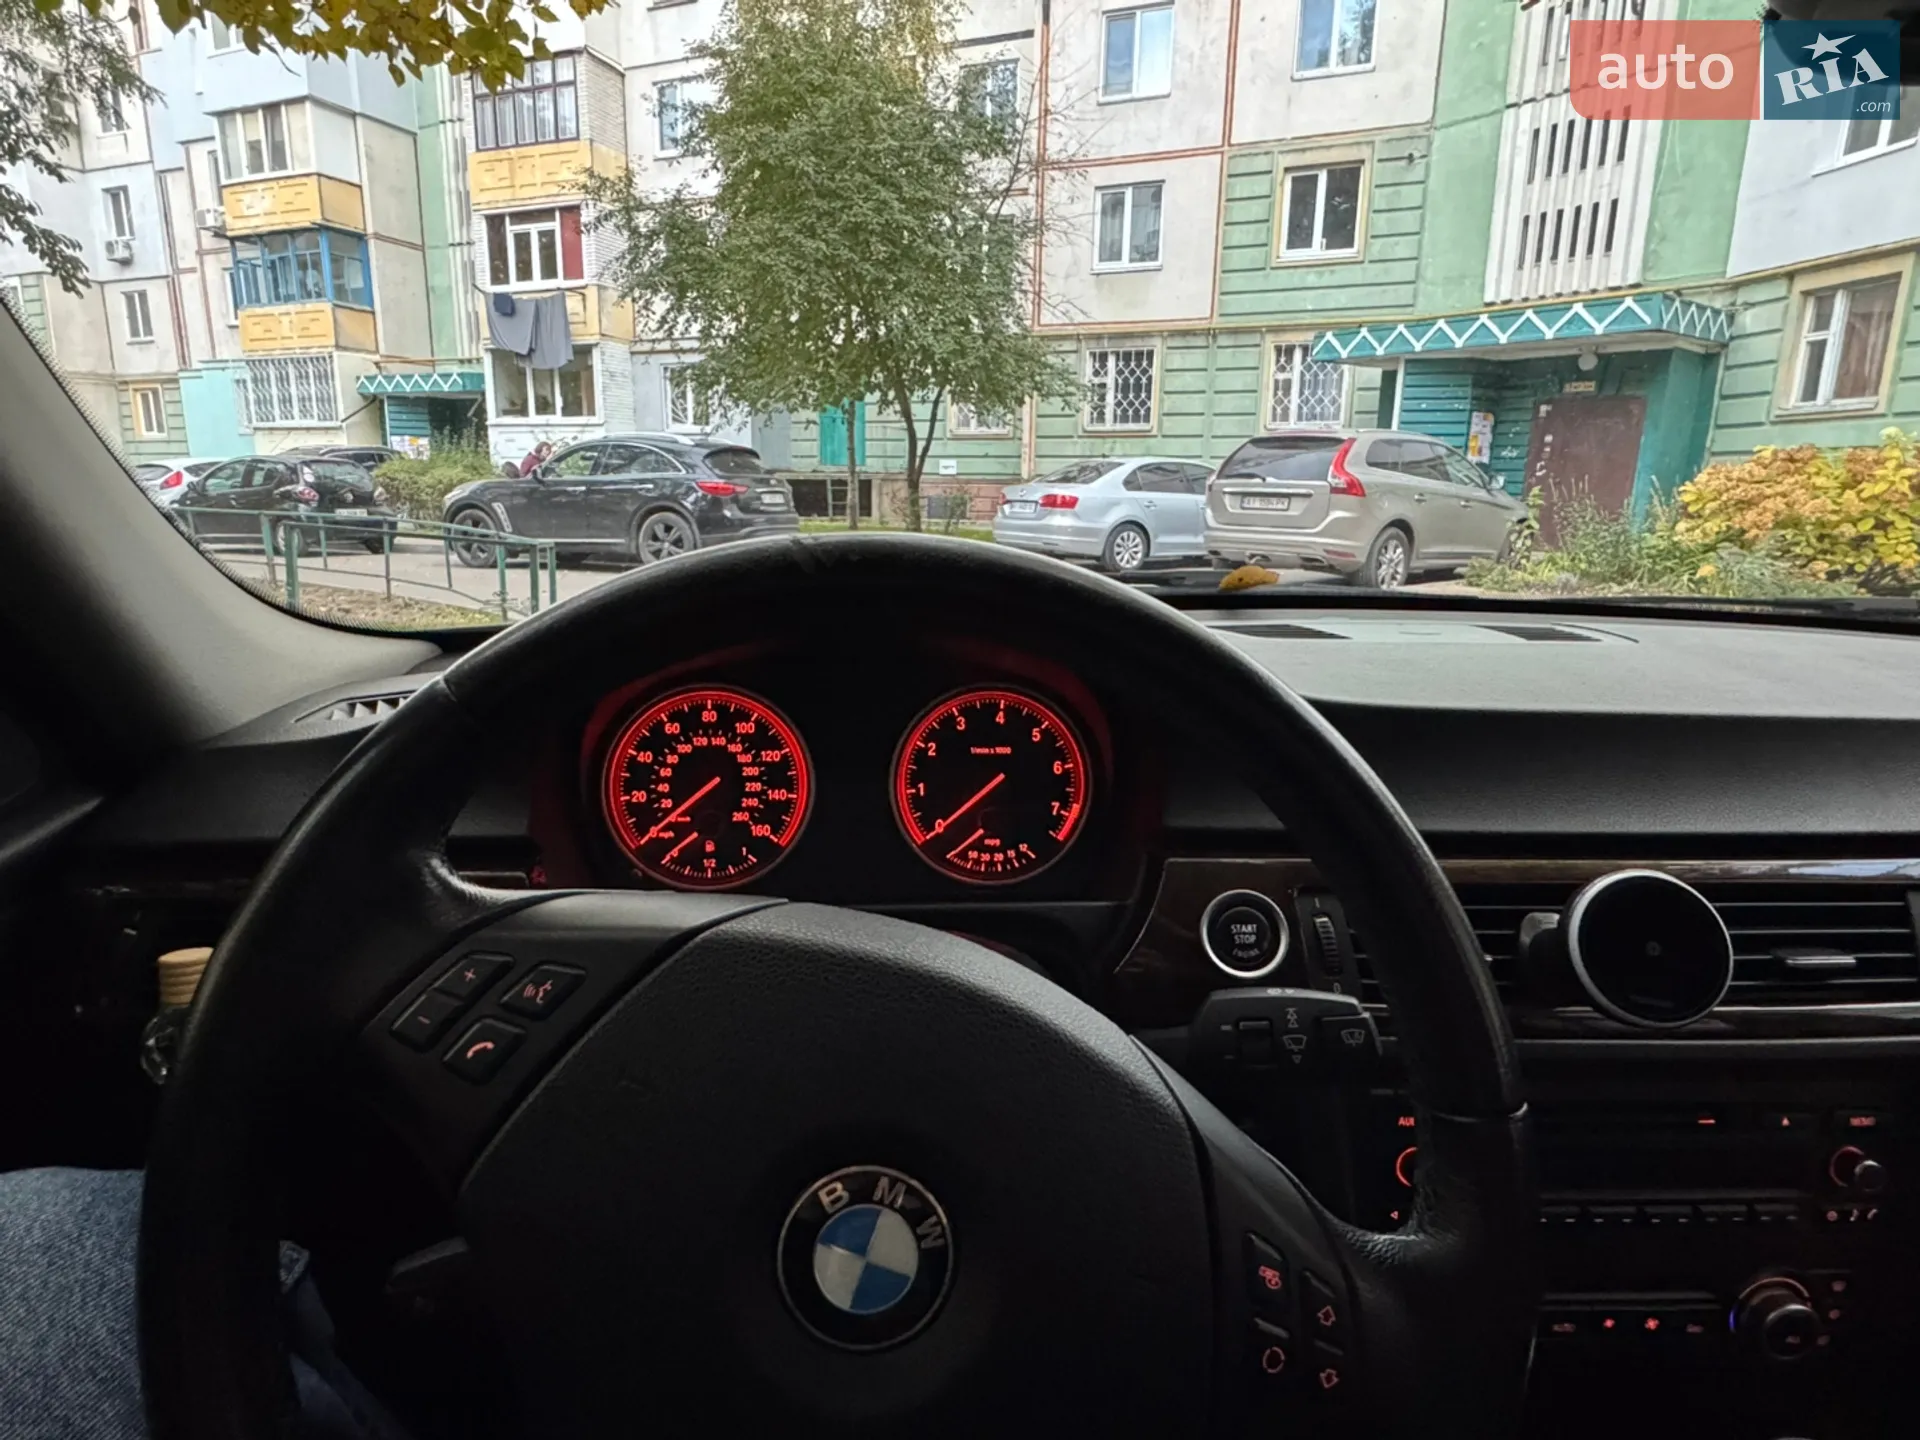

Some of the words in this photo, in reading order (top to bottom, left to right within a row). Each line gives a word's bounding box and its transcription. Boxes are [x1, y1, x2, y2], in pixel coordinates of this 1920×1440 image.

[702, 711, 717, 722] 80
[995, 712, 1005, 725] 4
[665, 723, 680, 734] 60
[735, 723, 755, 734] 100
[956, 717, 966, 731] 3
[1031, 728, 1041, 742] 5
[927, 742, 937, 756] 2
[637, 752, 653, 763] 40
[761, 751, 781, 762] 120
[742, 767, 759, 776] 200
[1053, 761, 1062, 775] 6
[657, 783, 669, 793] 40
[745, 782, 762, 791] 220
[918, 783, 924, 796] 1
[631, 791, 647, 802] 20
[767, 790, 787, 801] 140
[1051, 802, 1060, 816] 7
[751, 825, 771, 836] 160
[935, 819, 944, 833] 0
[703, 859, 716, 867] 1/2
[1230, 924, 1258, 934] START
[1233, 934, 1257, 944] STOP
[817, 1176, 946, 1250] BMW
